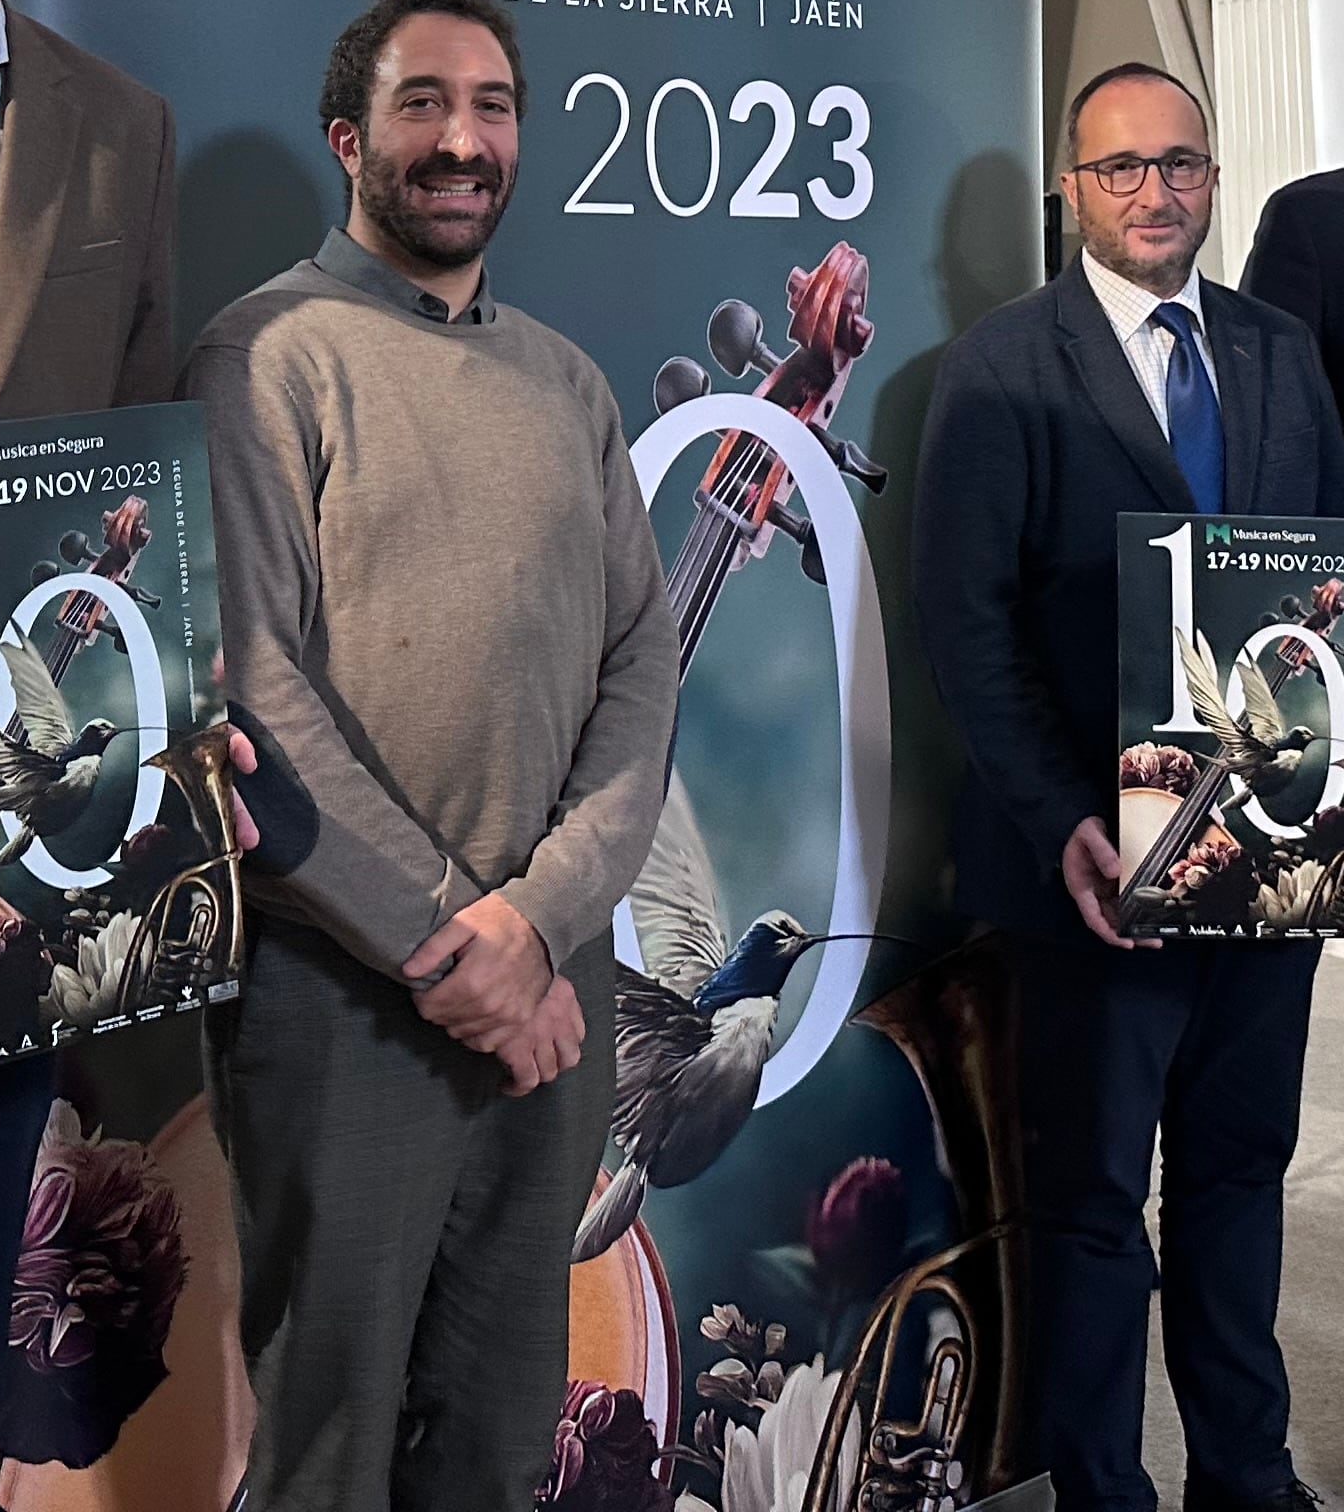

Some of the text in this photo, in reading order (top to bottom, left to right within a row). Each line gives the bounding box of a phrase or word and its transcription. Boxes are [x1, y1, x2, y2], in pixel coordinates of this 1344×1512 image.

[563, 72, 874, 221] 2023
[40, 441, 56, 456] en
[57, 436, 104, 455] Segura
[35, 468, 95, 500] NOV
[100, 460, 161, 491] 2023
[172, 459, 183, 508] SEGURA
[176, 511, 185, 527] DE
[177, 531, 186, 548] LA
[1268, 531, 1281, 541] en
[1282, 530, 1316, 544] Segura
[1207, 551, 1261, 570] 17-19
[1265, 553, 1308, 572] NOV
[179, 551, 190, 596] SIERRA
